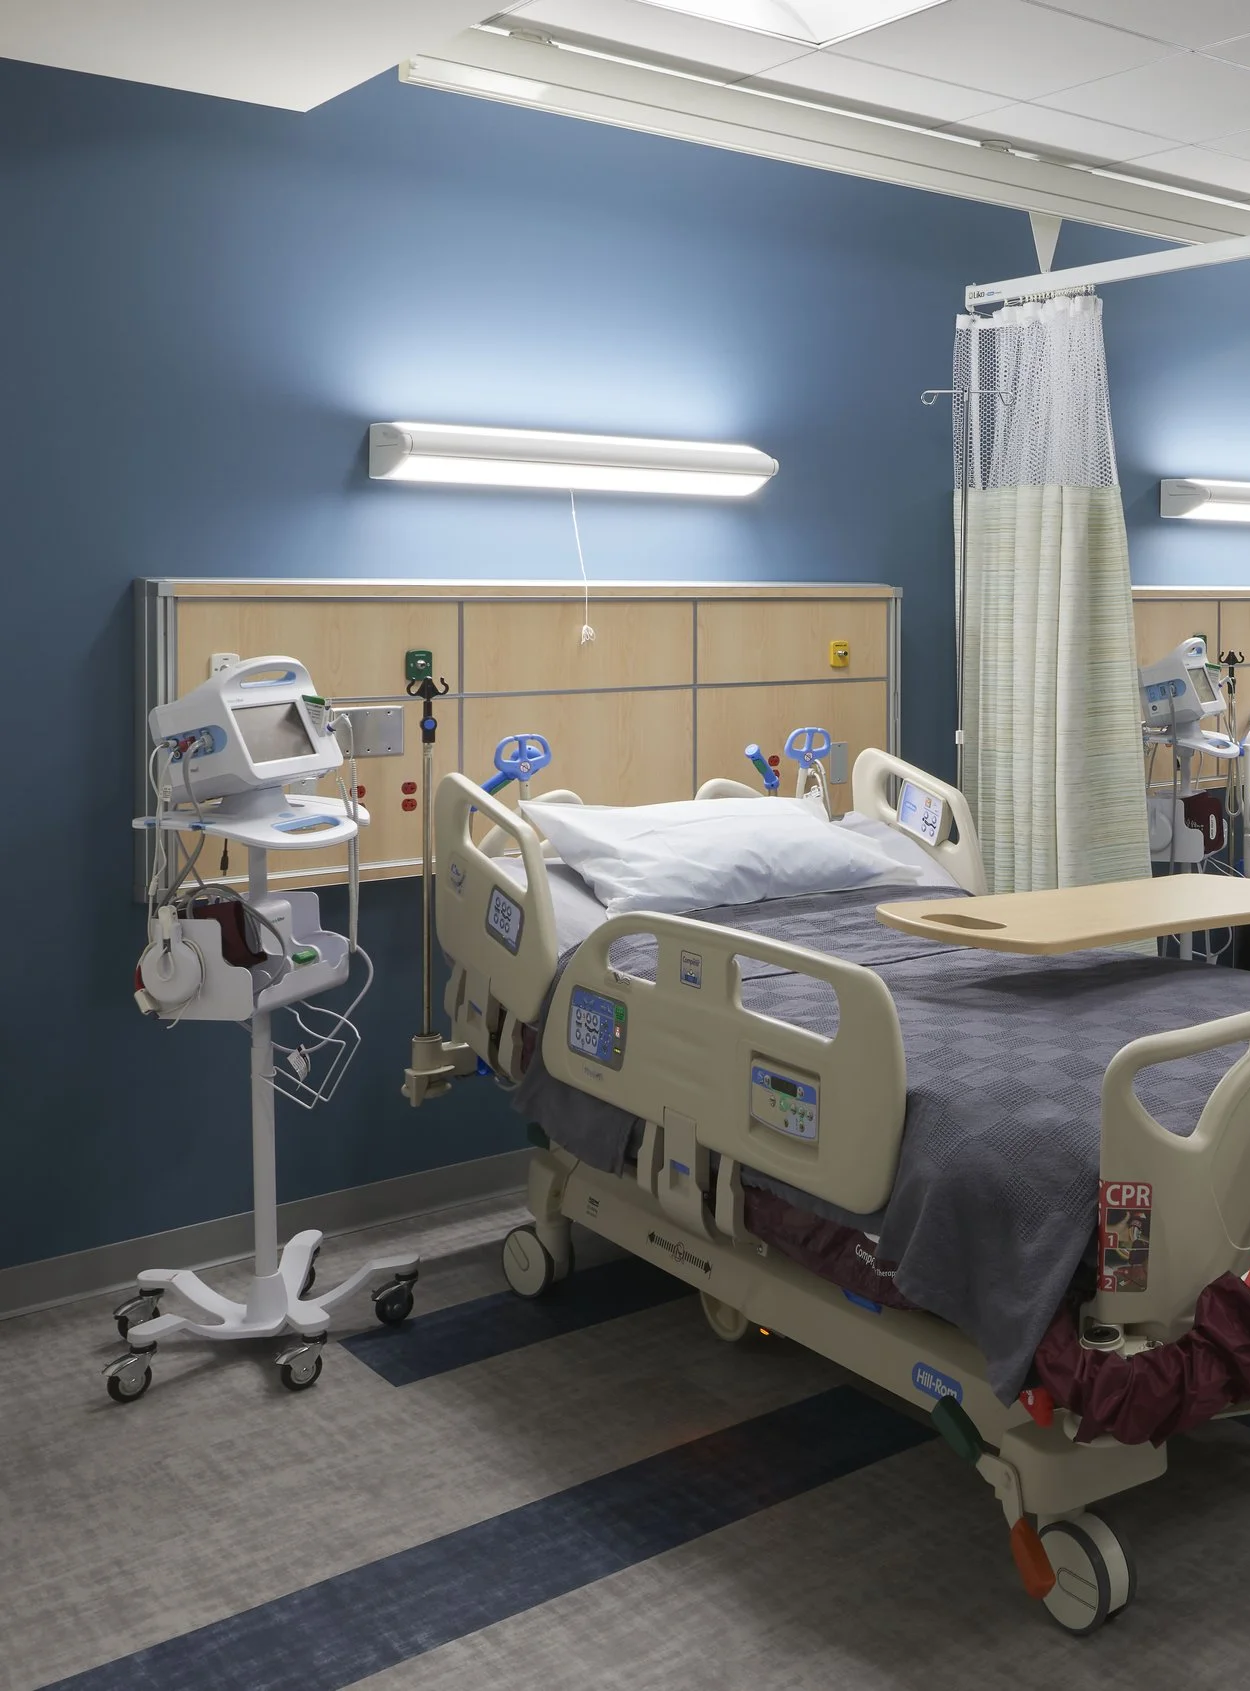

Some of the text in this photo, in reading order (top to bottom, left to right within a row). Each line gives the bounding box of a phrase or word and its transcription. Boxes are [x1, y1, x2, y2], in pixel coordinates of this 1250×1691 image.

[1106, 1184, 1151, 1206] CPR
[1108, 1235, 1114, 1247] 1
[1104, 1278, 1113, 1289] 2
[916, 1368, 958, 1399] Hill-Rom
